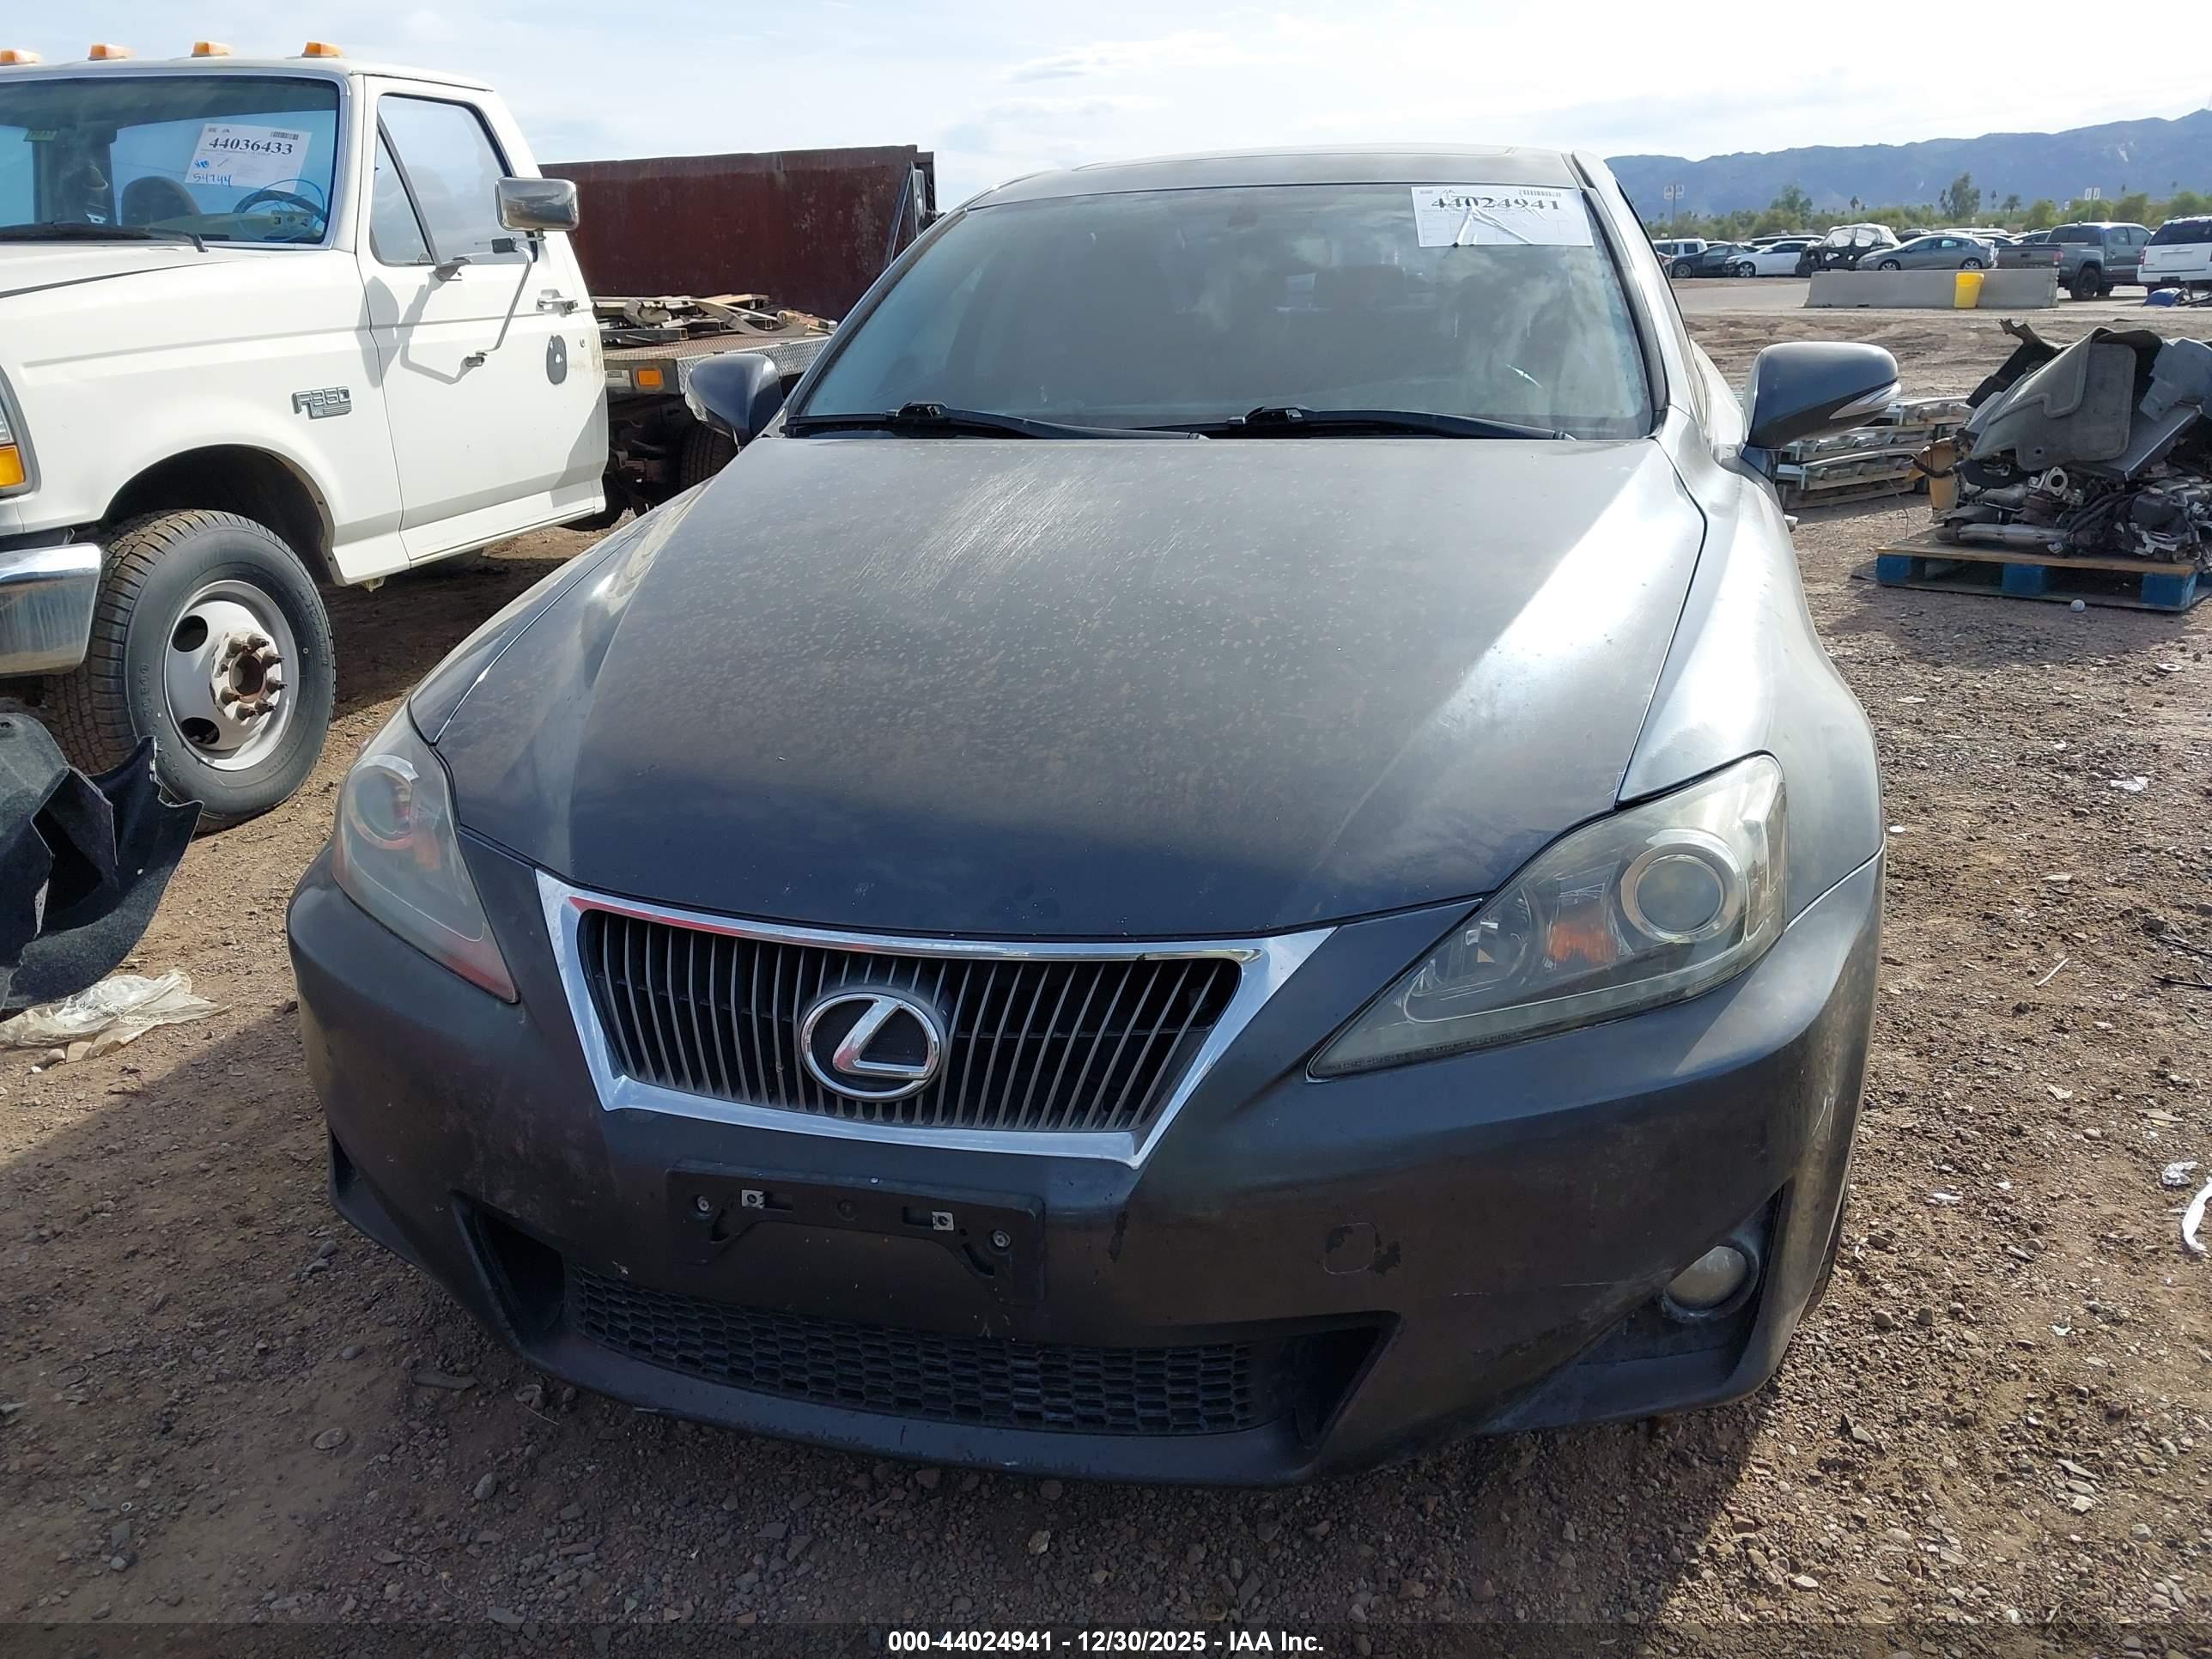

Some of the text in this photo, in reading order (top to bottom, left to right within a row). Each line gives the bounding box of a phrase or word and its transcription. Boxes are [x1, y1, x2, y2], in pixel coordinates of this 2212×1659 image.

[209, 137, 294, 155] 44036433
[1431, 197, 1559, 210] 44024941
[292, 386, 350, 414] F350
